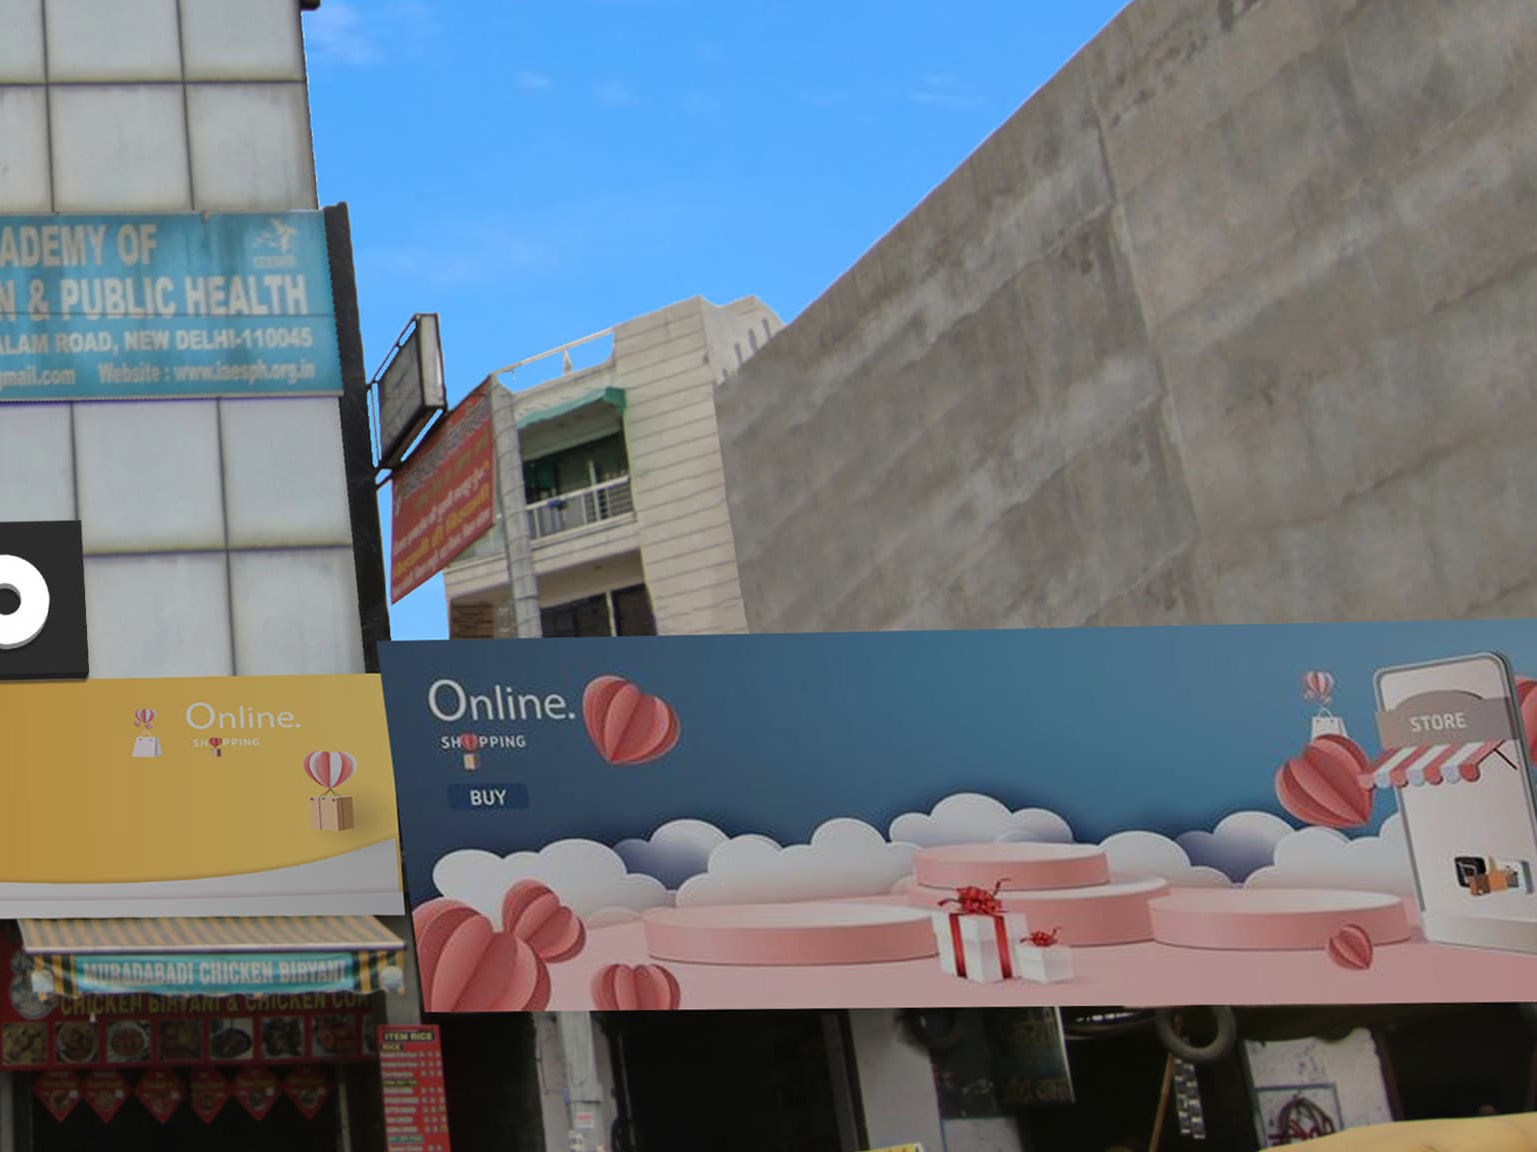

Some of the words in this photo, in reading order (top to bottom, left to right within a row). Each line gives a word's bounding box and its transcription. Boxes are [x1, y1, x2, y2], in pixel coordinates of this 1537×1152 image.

[116, 223, 158, 266] OF
[28, 279, 51, 321] &
[60, 276, 176, 320] PUBLIC
[185, 273, 309, 317] HEALTH
[56, 331, 119, 355] ROAD,
[124, 329, 170, 350] NEW
[176, 326, 313, 350] DELHI-110045
[98, 362, 161, 384] Website
[428, 679, 576, 722] Online.
[186, 702, 301, 730] Online.
[1408, 711, 1468, 733] STORE
[470, 789, 507, 806] BUY
[199, 960, 274, 985] CHICKEN
[279, 959, 347, 983] BIRYANI
